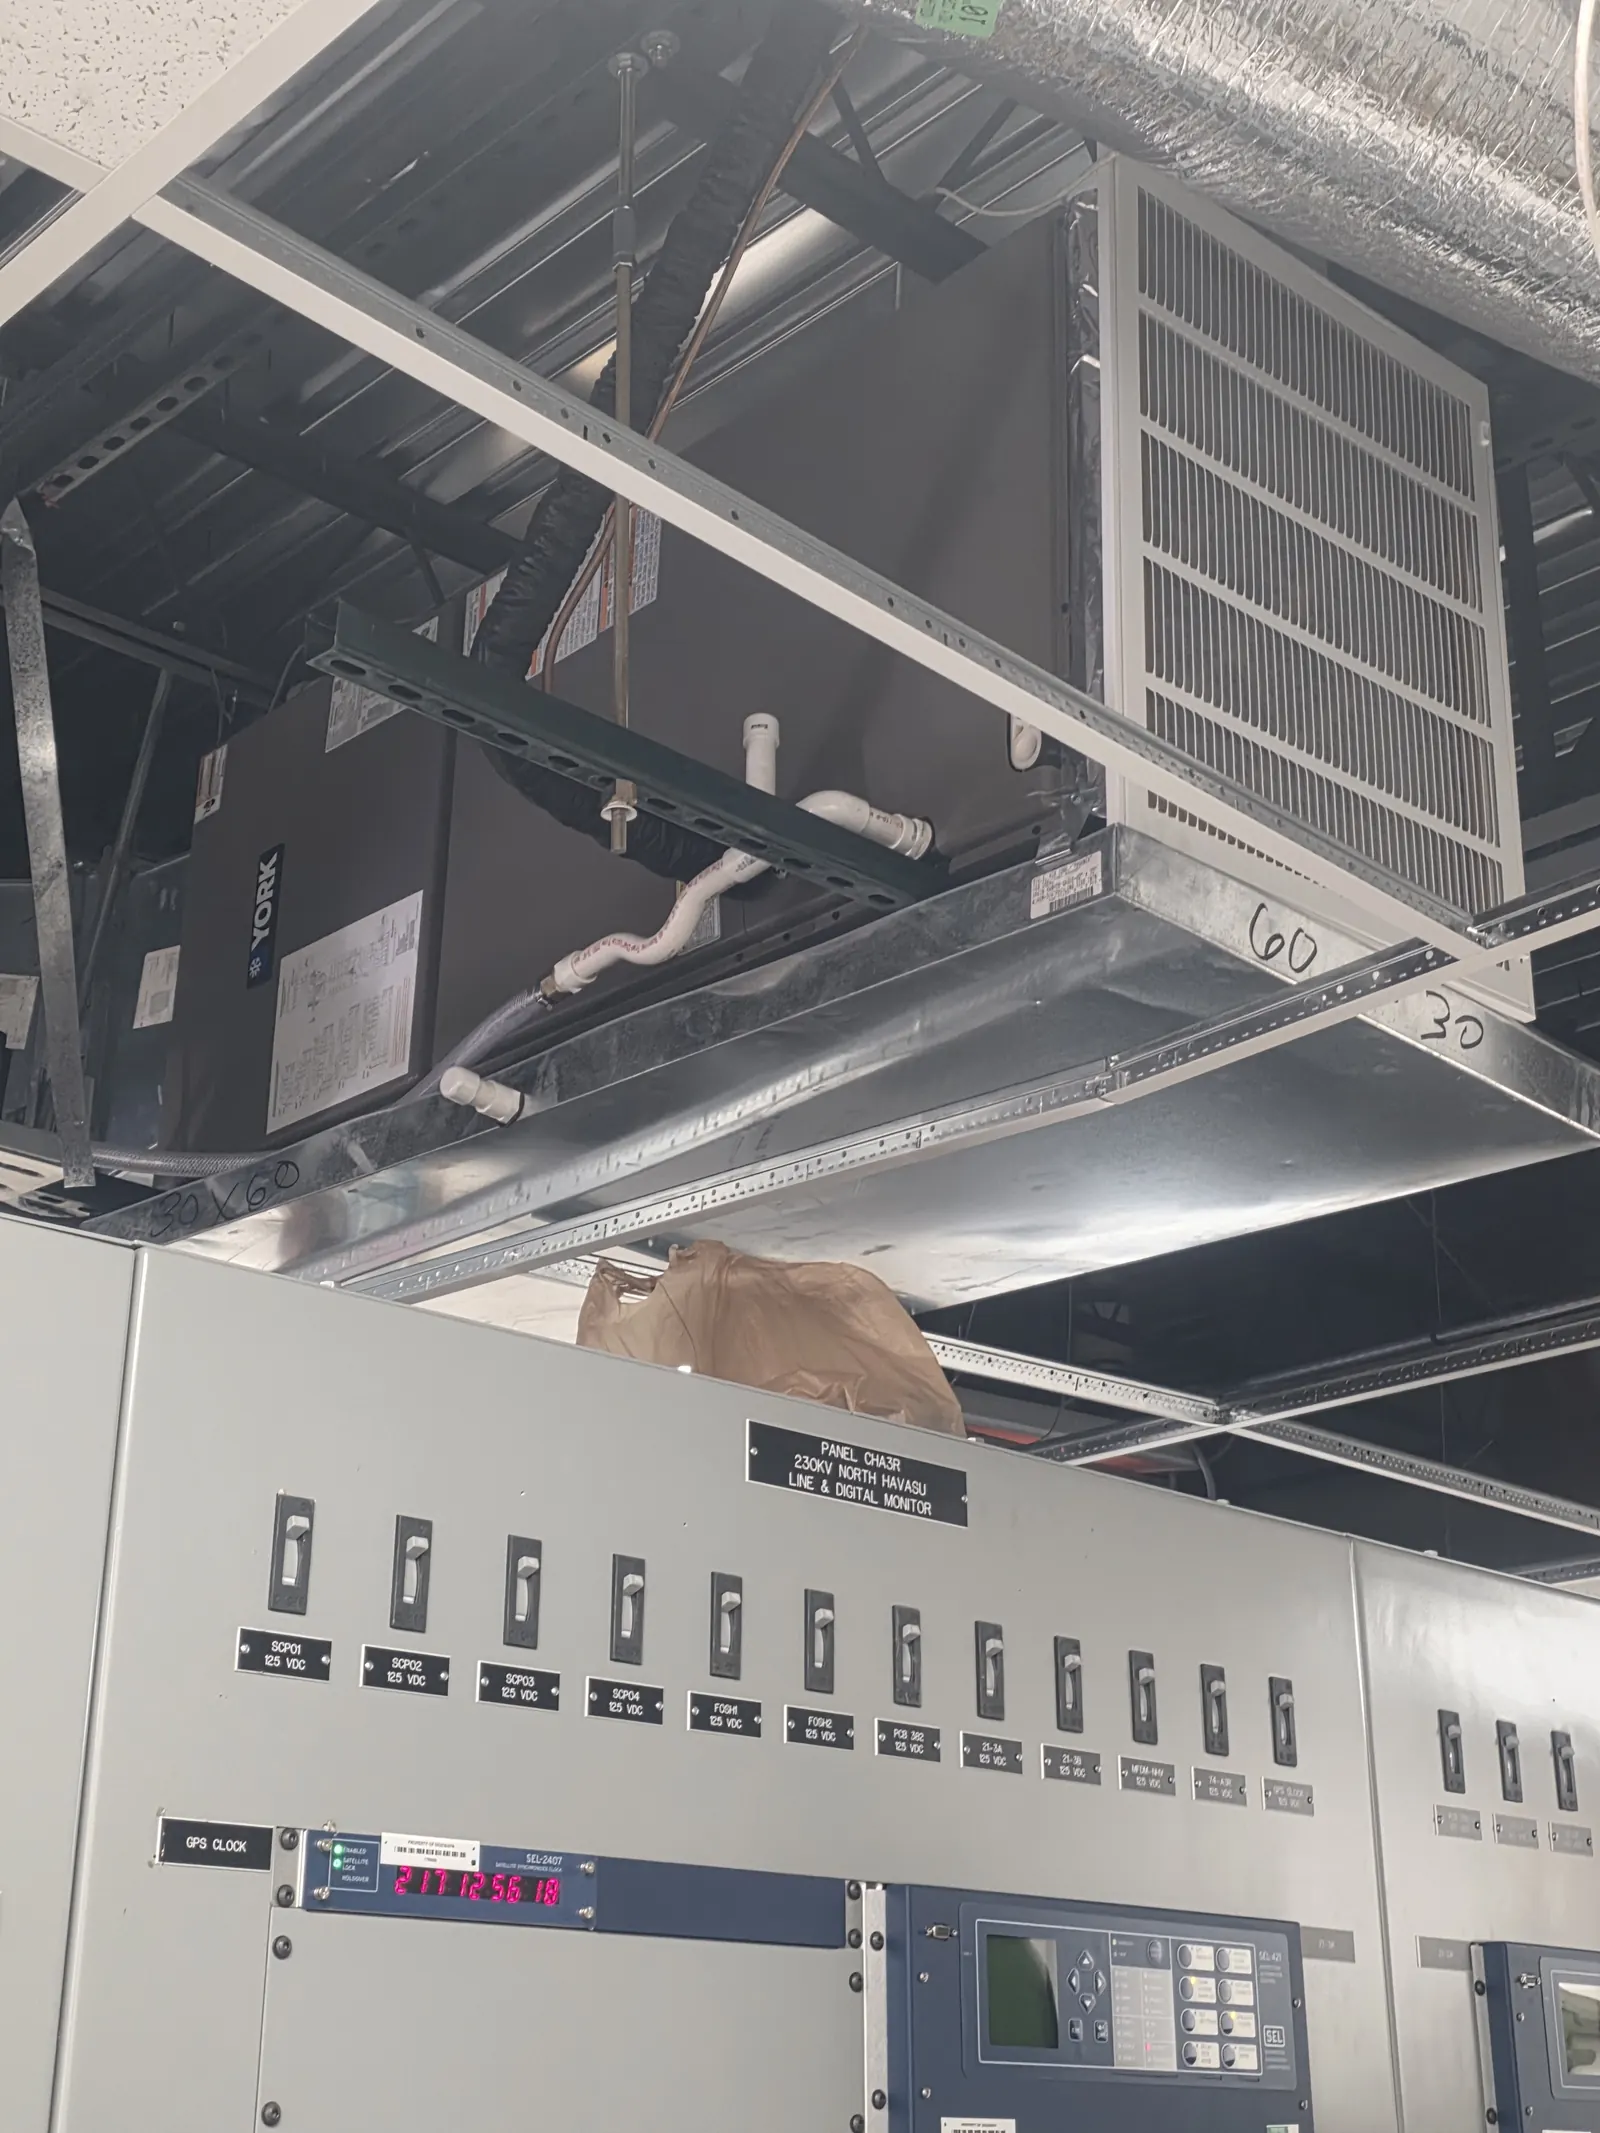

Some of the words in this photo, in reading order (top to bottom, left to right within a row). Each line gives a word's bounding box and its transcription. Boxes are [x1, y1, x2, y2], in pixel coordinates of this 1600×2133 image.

[250, 852, 278, 952] YORK
[1249, 902, 1318, 974] 60
[1421, 989, 1484, 1050] 30
[821, 1441, 858, 1463] PANEL
[864, 1451, 901, 1473] CHA3R
[794, 1454, 833, 1475] 230KV
[838, 1465, 877, 1486] NORTH
[881, 1473, 927, 1497] HAVASU
[788, 1472, 814, 1491] LINE
[820, 1479, 830, 1494] &
[836, 1481, 879, 1505] DIGITAL
[884, 1492, 932, 1516] MONITOR
[271, 1640, 302, 1655] SCP01
[264, 1654, 281, 1667] 125
[286, 1657, 306, 1671] VDC
[391, 1657, 422, 1672] SCP02
[387, 1671, 402, 1684] 125
[407, 1674, 426, 1687] VDC
[505, 1673, 535, 1687] SCP03
[501, 1686, 516, 1698] 125
[520, 1689, 538, 1702] VDC
[612, 1688, 640, 1701] SCP04
[608, 1701, 623, 1713] 125
[626, 1703, 643, 1716] VDC
[709, 1715, 723, 1727] 125
[726, 1717, 743, 1729] VDC
[805, 1728, 818, 1740] 125
[820, 1730, 836, 1742] VDC
[893, 1728, 908, 1740] PCB
[894, 1741, 907, 1752] 125
[910, 1743, 924, 1755] VDC
[979, 1753, 990, 1764] 125
[992, 1755, 1007, 1766] VDC
[186, 1835, 207, 1850] GPS
[212, 1838, 247, 1853] CLOCK
[526, 1853, 563, 1866] SEL-2407
[1266, 2029, 1283, 2044] SEL
